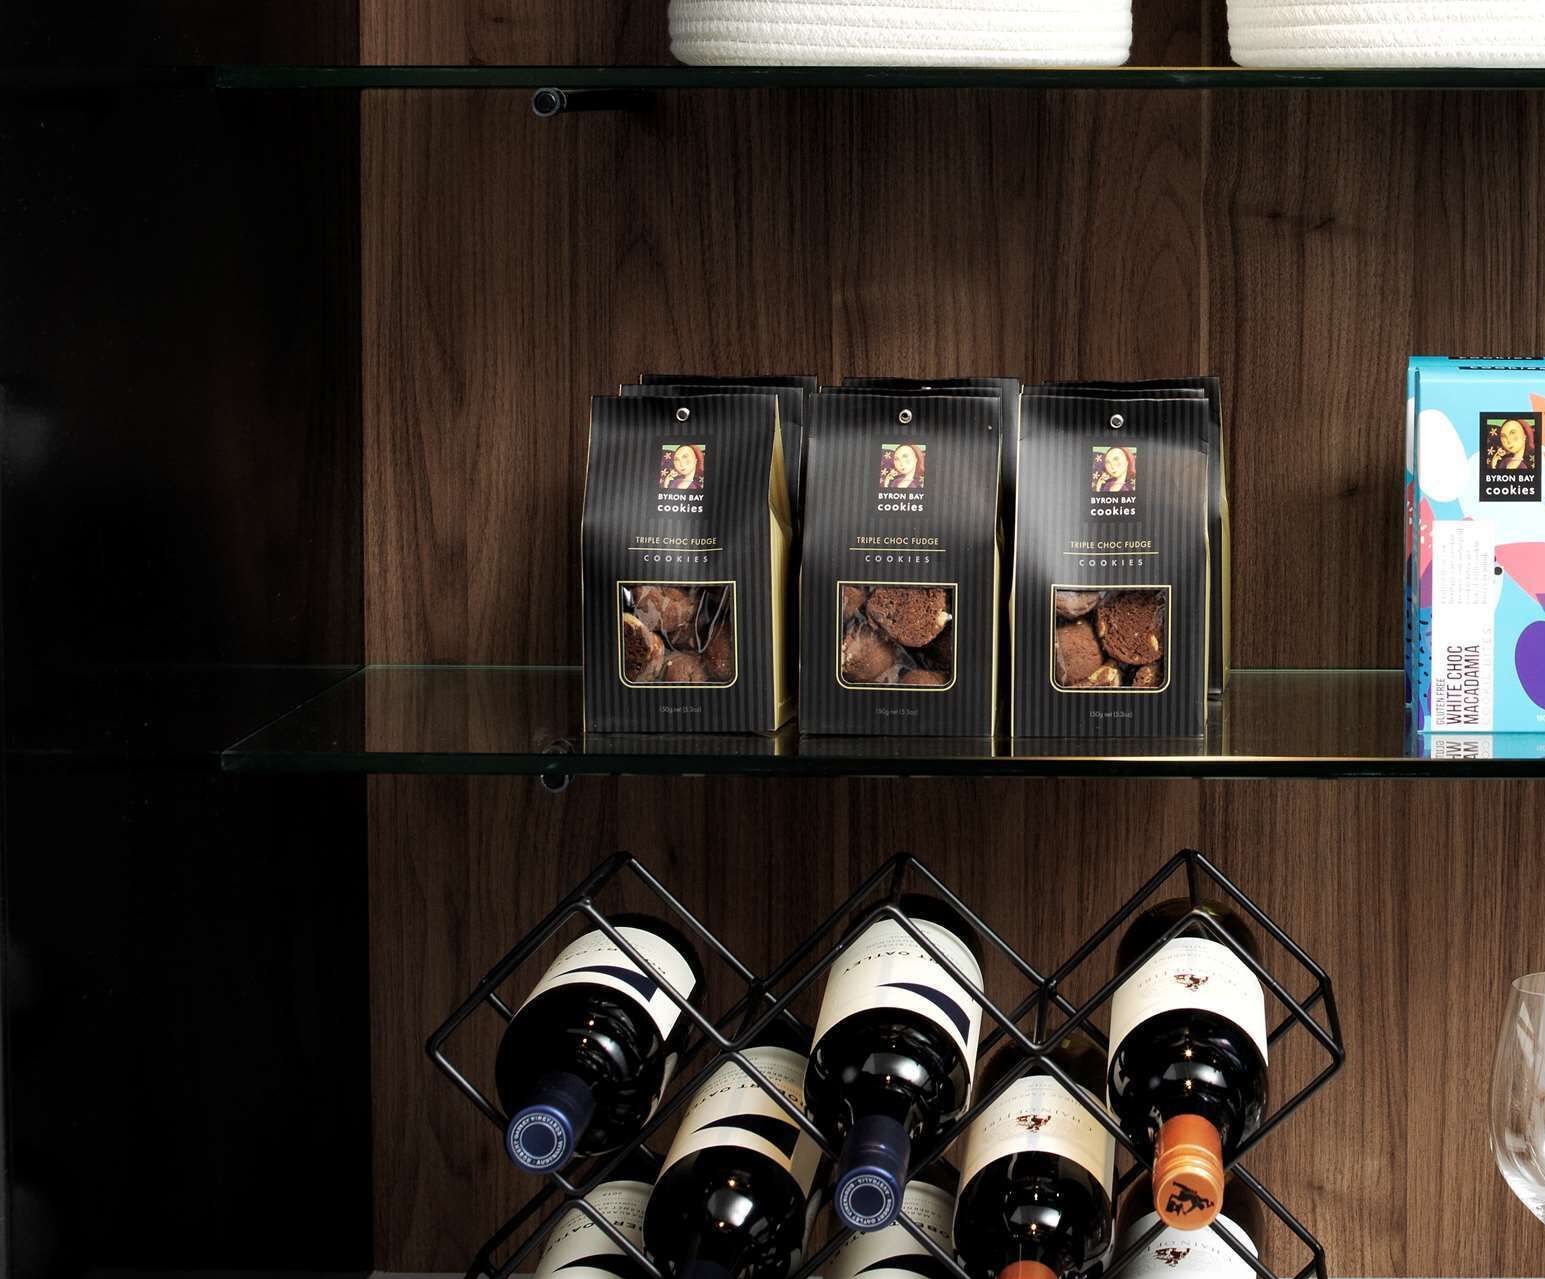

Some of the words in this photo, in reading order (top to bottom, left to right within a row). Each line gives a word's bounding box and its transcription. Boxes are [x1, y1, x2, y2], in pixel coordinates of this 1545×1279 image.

[1486, 474, 1516, 482] BYRON
[1518, 474, 1535, 482] BAY
[1486, 485, 1535, 496] cookies
[658, 493, 686, 501] BYRON
[688, 493, 704, 501] BAY
[878, 492, 906, 500] BYRON
[908, 492, 924, 500] BAY
[1090, 496, 1118, 504] BYRON
[1121, 496, 1136, 504] BAY
[657, 503, 703, 513] cookies
[878, 502, 923, 512] cookies
[1090, 506, 1136, 516] cookies
[636, 536, 660, 544] TRIPLE
[663, 537, 688, 545] CHOC
[690, 537, 718, 545] FUDGE
[856, 536, 881, 545] TRIPLE
[884, 537, 909, 545] CHOC
[912, 538, 939, 546] FUDGE
[644, 554, 709, 563] COOKIES
[865, 555, 930, 564] COOKIES
[1447, 645, 1462, 680] CHOC
[1436, 678, 1445, 696] FREE
[1464, 644, 1479, 725] MACADAMIA
[1447, 684, 1462, 725] WHITE
[1436, 697, 1445, 726] GLUTEN
